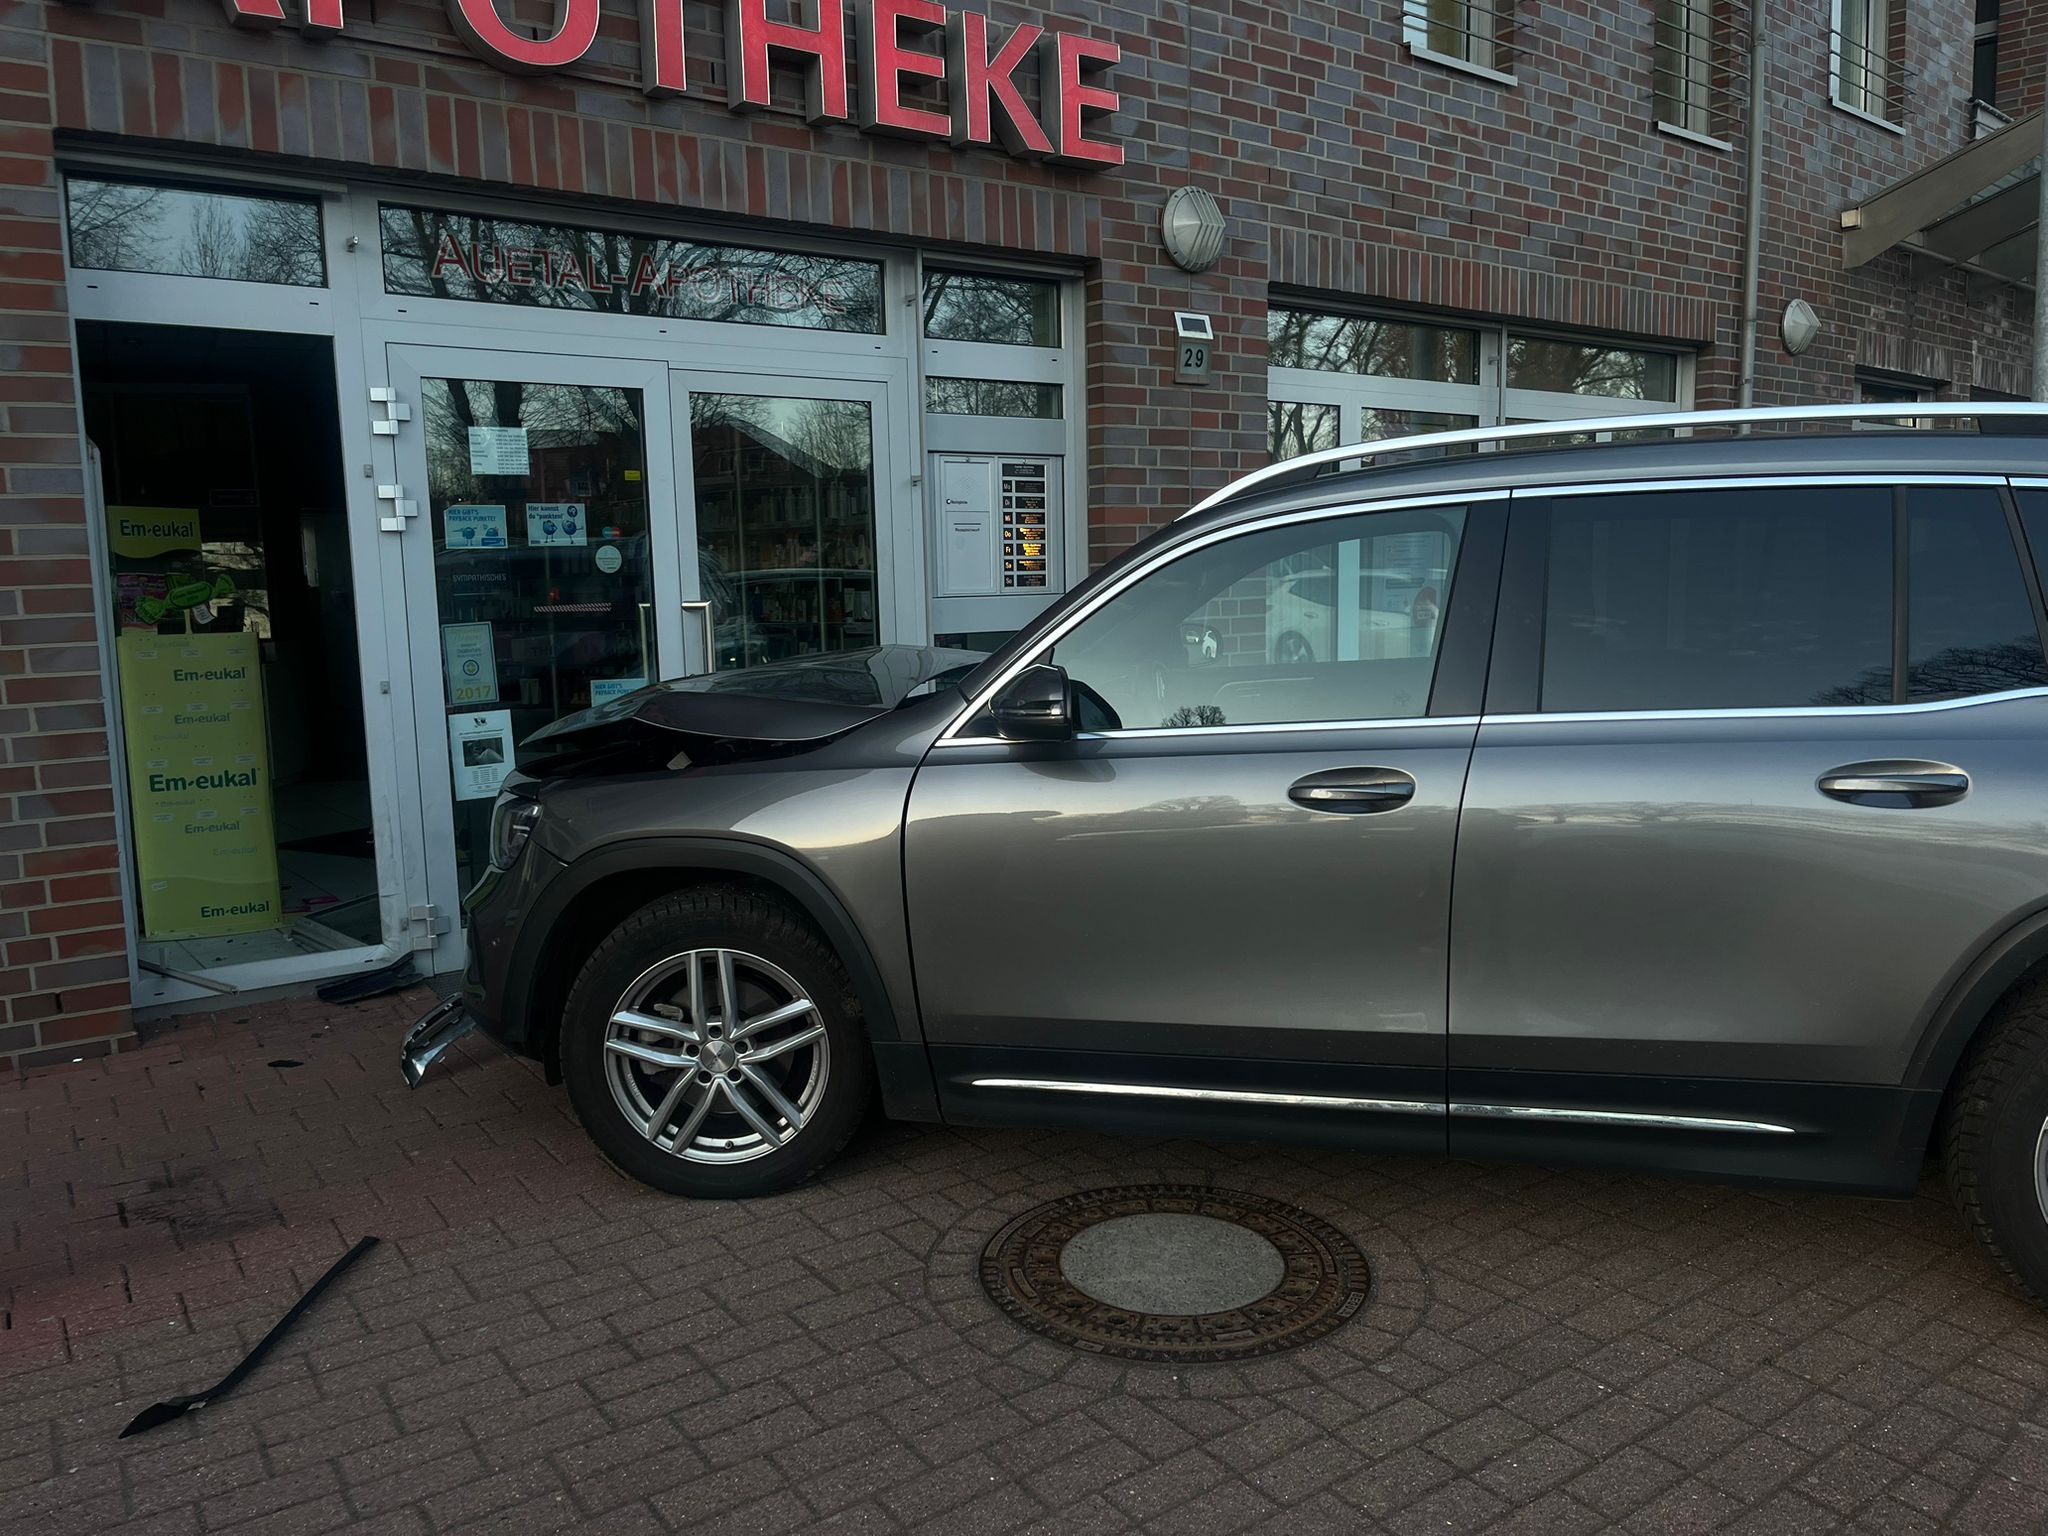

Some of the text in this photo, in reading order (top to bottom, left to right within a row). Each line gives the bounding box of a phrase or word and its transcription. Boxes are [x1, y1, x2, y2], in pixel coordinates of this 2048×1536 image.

[230, 0, 1125, 164] OTHEKE
[431, 233, 846, 315] AUETAL-APOTHEKE
[1184, 348, 1204, 368] 29
[120, 519, 194, 538] Em-eukal
[174, 667, 246, 681] Em-eukal
[456, 685, 491, 700] 2017
[174, 712, 230, 724] Em-eukal
[149, 767, 257, 792] Em-eukal
[185, 821, 240, 834] Em-eukal
[200, 900, 270, 918] Em-eukal
